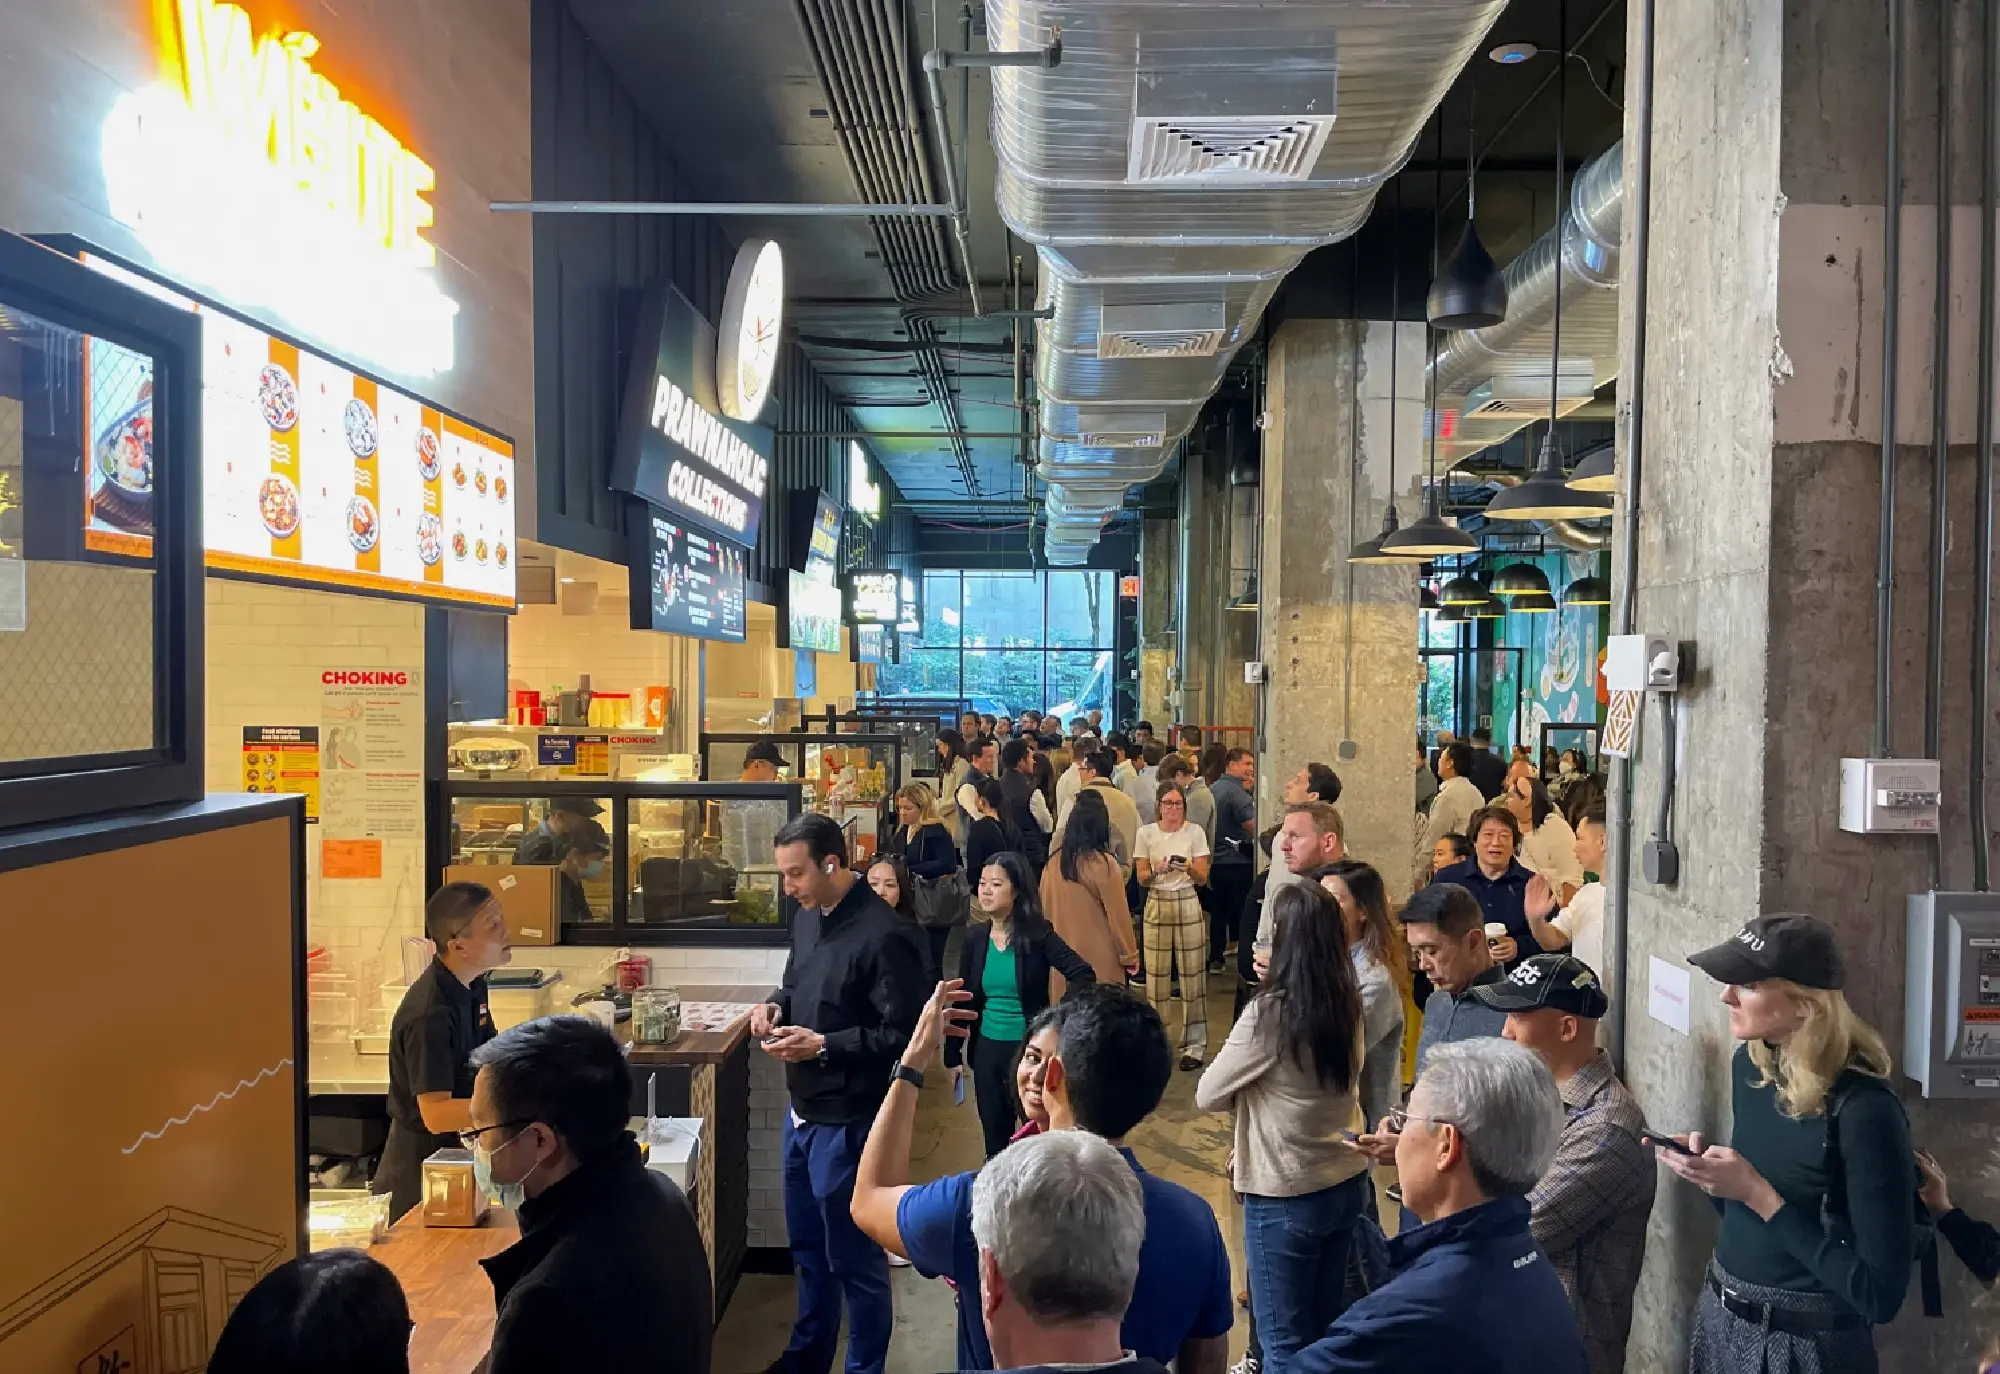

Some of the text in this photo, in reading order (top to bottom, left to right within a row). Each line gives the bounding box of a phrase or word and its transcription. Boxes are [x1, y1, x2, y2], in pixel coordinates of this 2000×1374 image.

[651, 374, 767, 497] PRAWNAHOLIC
[667, 460, 747, 532] COLLECTIONS
[322, 671, 407, 685] CHOKING
[610, 736, 656, 744] CHOKING
[1913, 819, 1934, 828] FIRE
